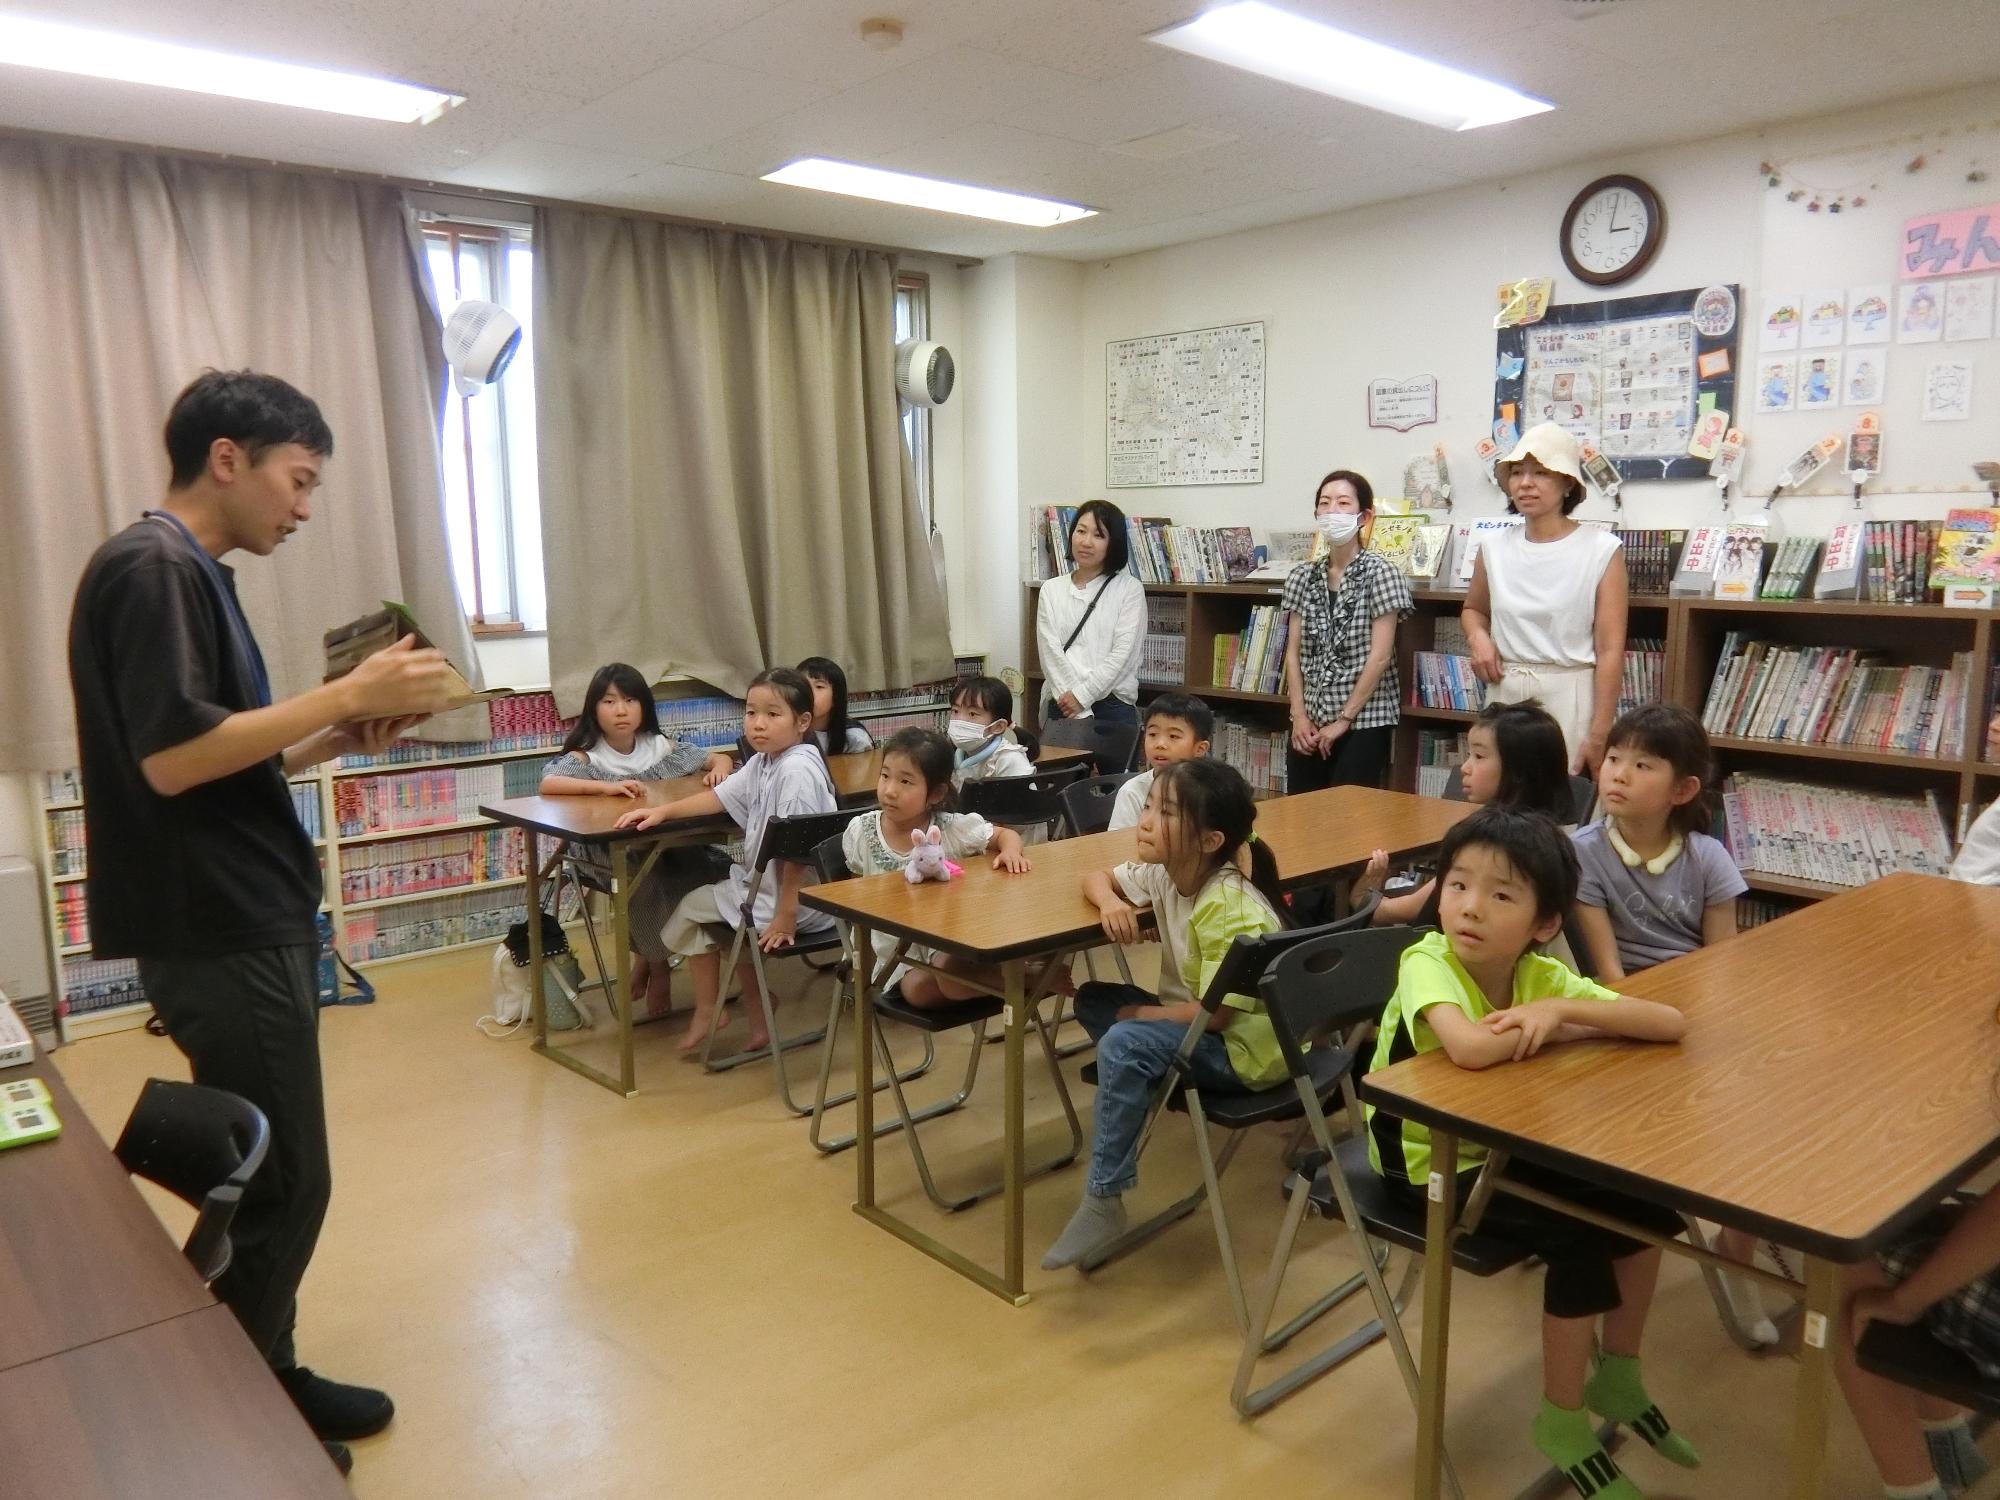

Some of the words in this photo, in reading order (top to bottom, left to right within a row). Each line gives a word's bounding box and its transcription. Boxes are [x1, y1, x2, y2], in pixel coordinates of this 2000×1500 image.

[1686, 527, 1710, 570] 貸出中
[1826, 525, 1848, 570] 貸出中
